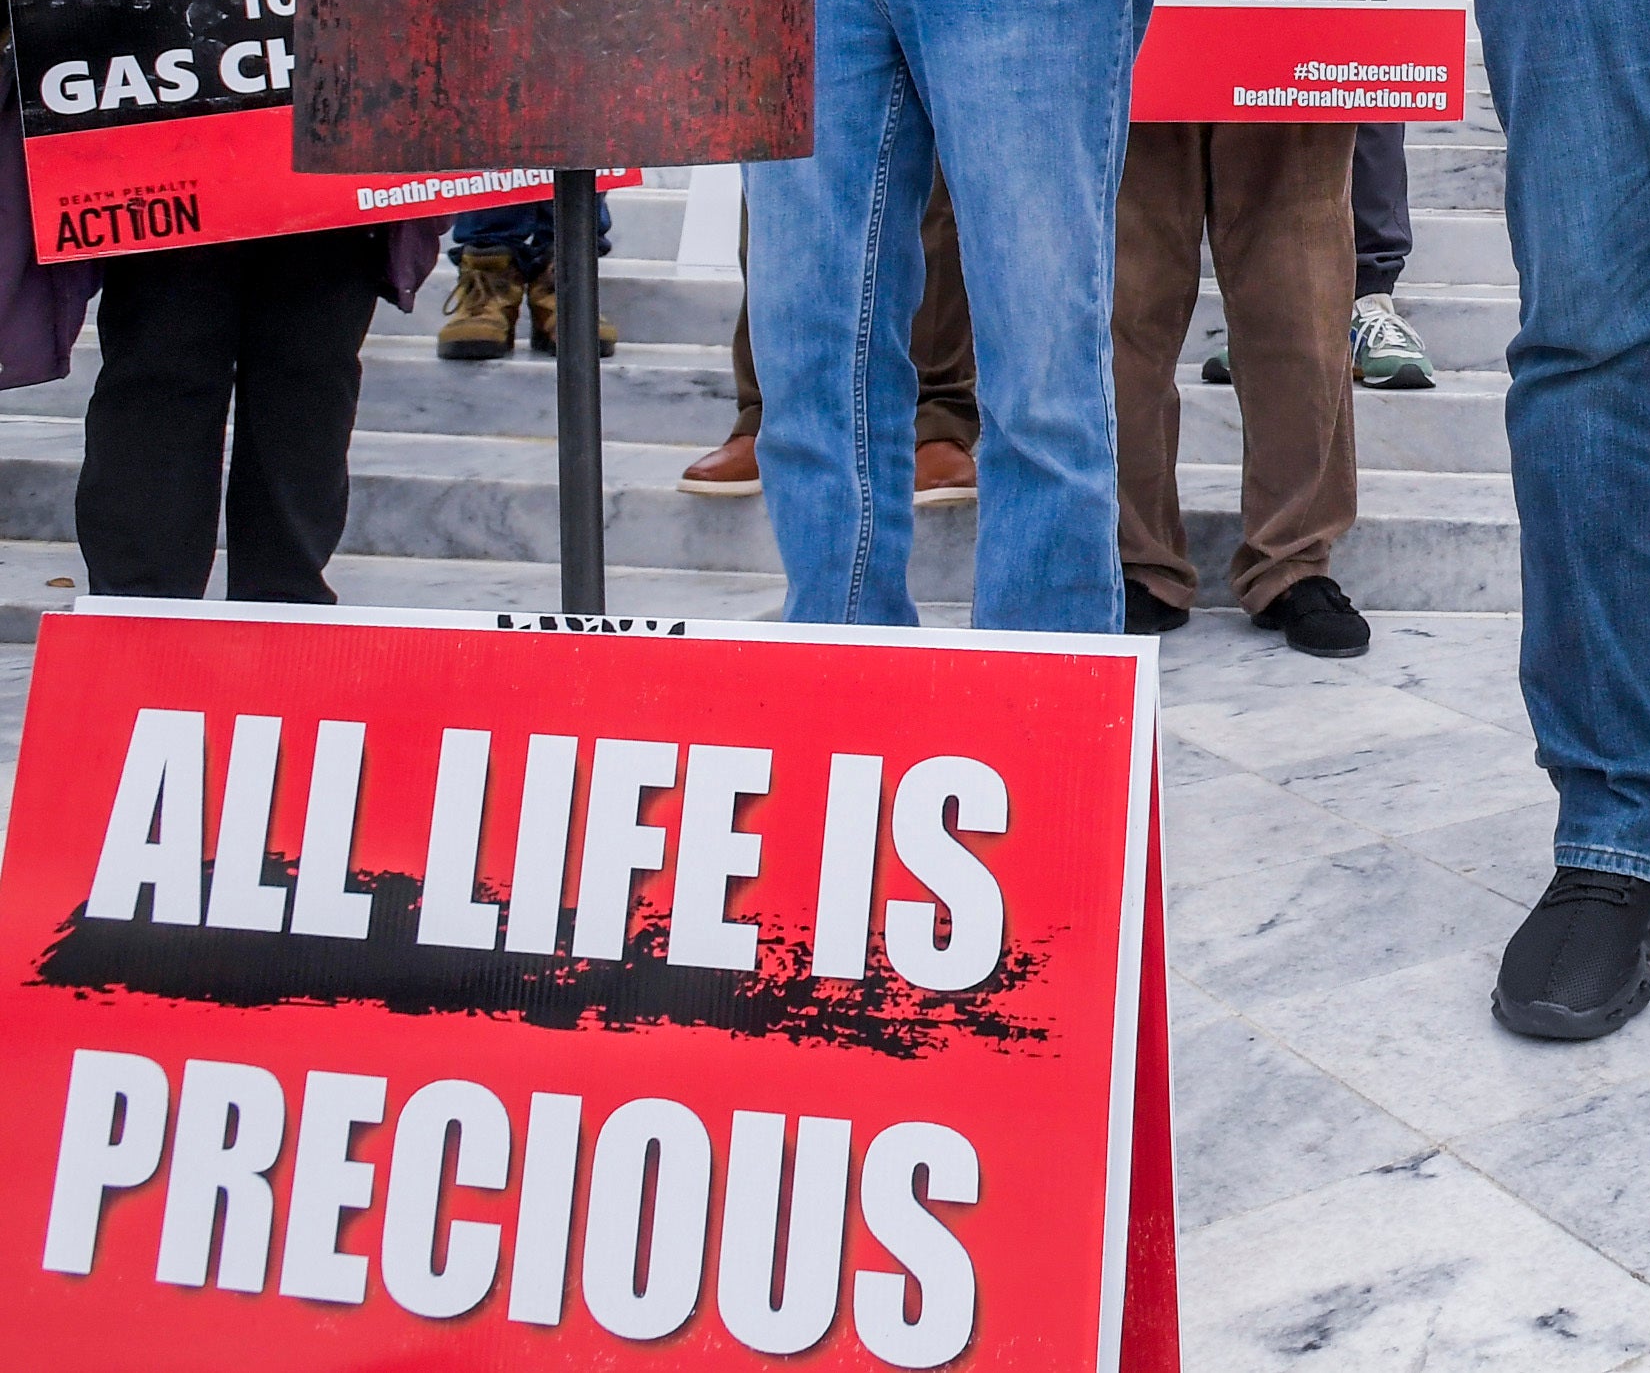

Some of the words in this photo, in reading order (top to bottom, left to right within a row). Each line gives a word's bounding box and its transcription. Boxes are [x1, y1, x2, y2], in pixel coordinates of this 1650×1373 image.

[40, 48, 200, 115] GAS
[220, 37, 296, 94] CH
[1233, 87, 1447, 111] DeathPenaltyAction.org
[1293, 61, 1448, 83] #StopExecutions
[59, 190, 115, 207] DEATH
[122, 179, 198, 197] PENALTY
[56, 194, 201, 252] ACTION
[85, 708, 374, 941] ALL
[418, 728, 772, 971] LIFE
[811, 754, 1008, 991] IS
[42, 1048, 979, 1368] PRECIOUS
